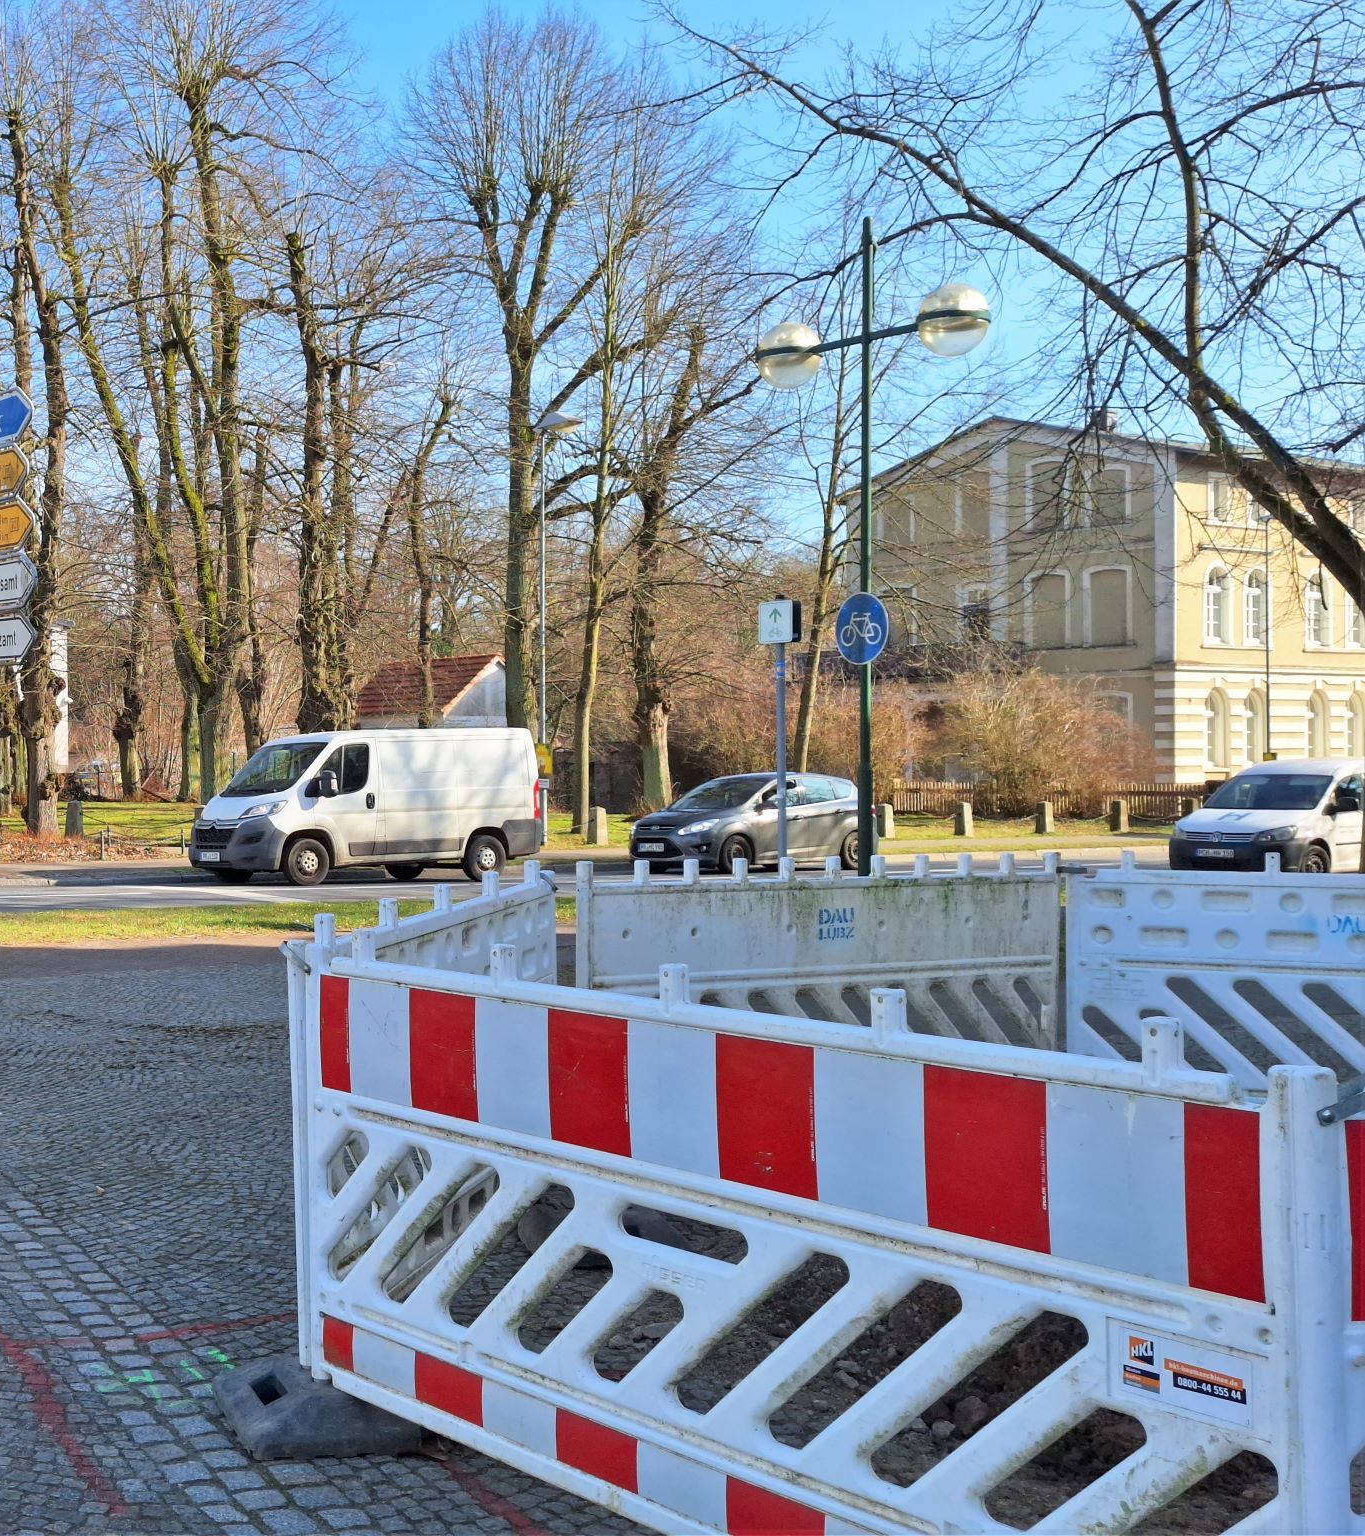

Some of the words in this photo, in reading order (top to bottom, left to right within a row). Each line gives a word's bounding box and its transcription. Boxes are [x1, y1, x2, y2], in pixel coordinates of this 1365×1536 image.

[1218, 812, 1252, 820] H
[819, 907, 854, 925] DAU
[1131, 1341, 1153, 1357] HKL
[1177, 1377, 1212, 1393] 0800-44
[1213, 1386, 1229, 1397] 555
[1231, 1390, 1241, 1400] 44
